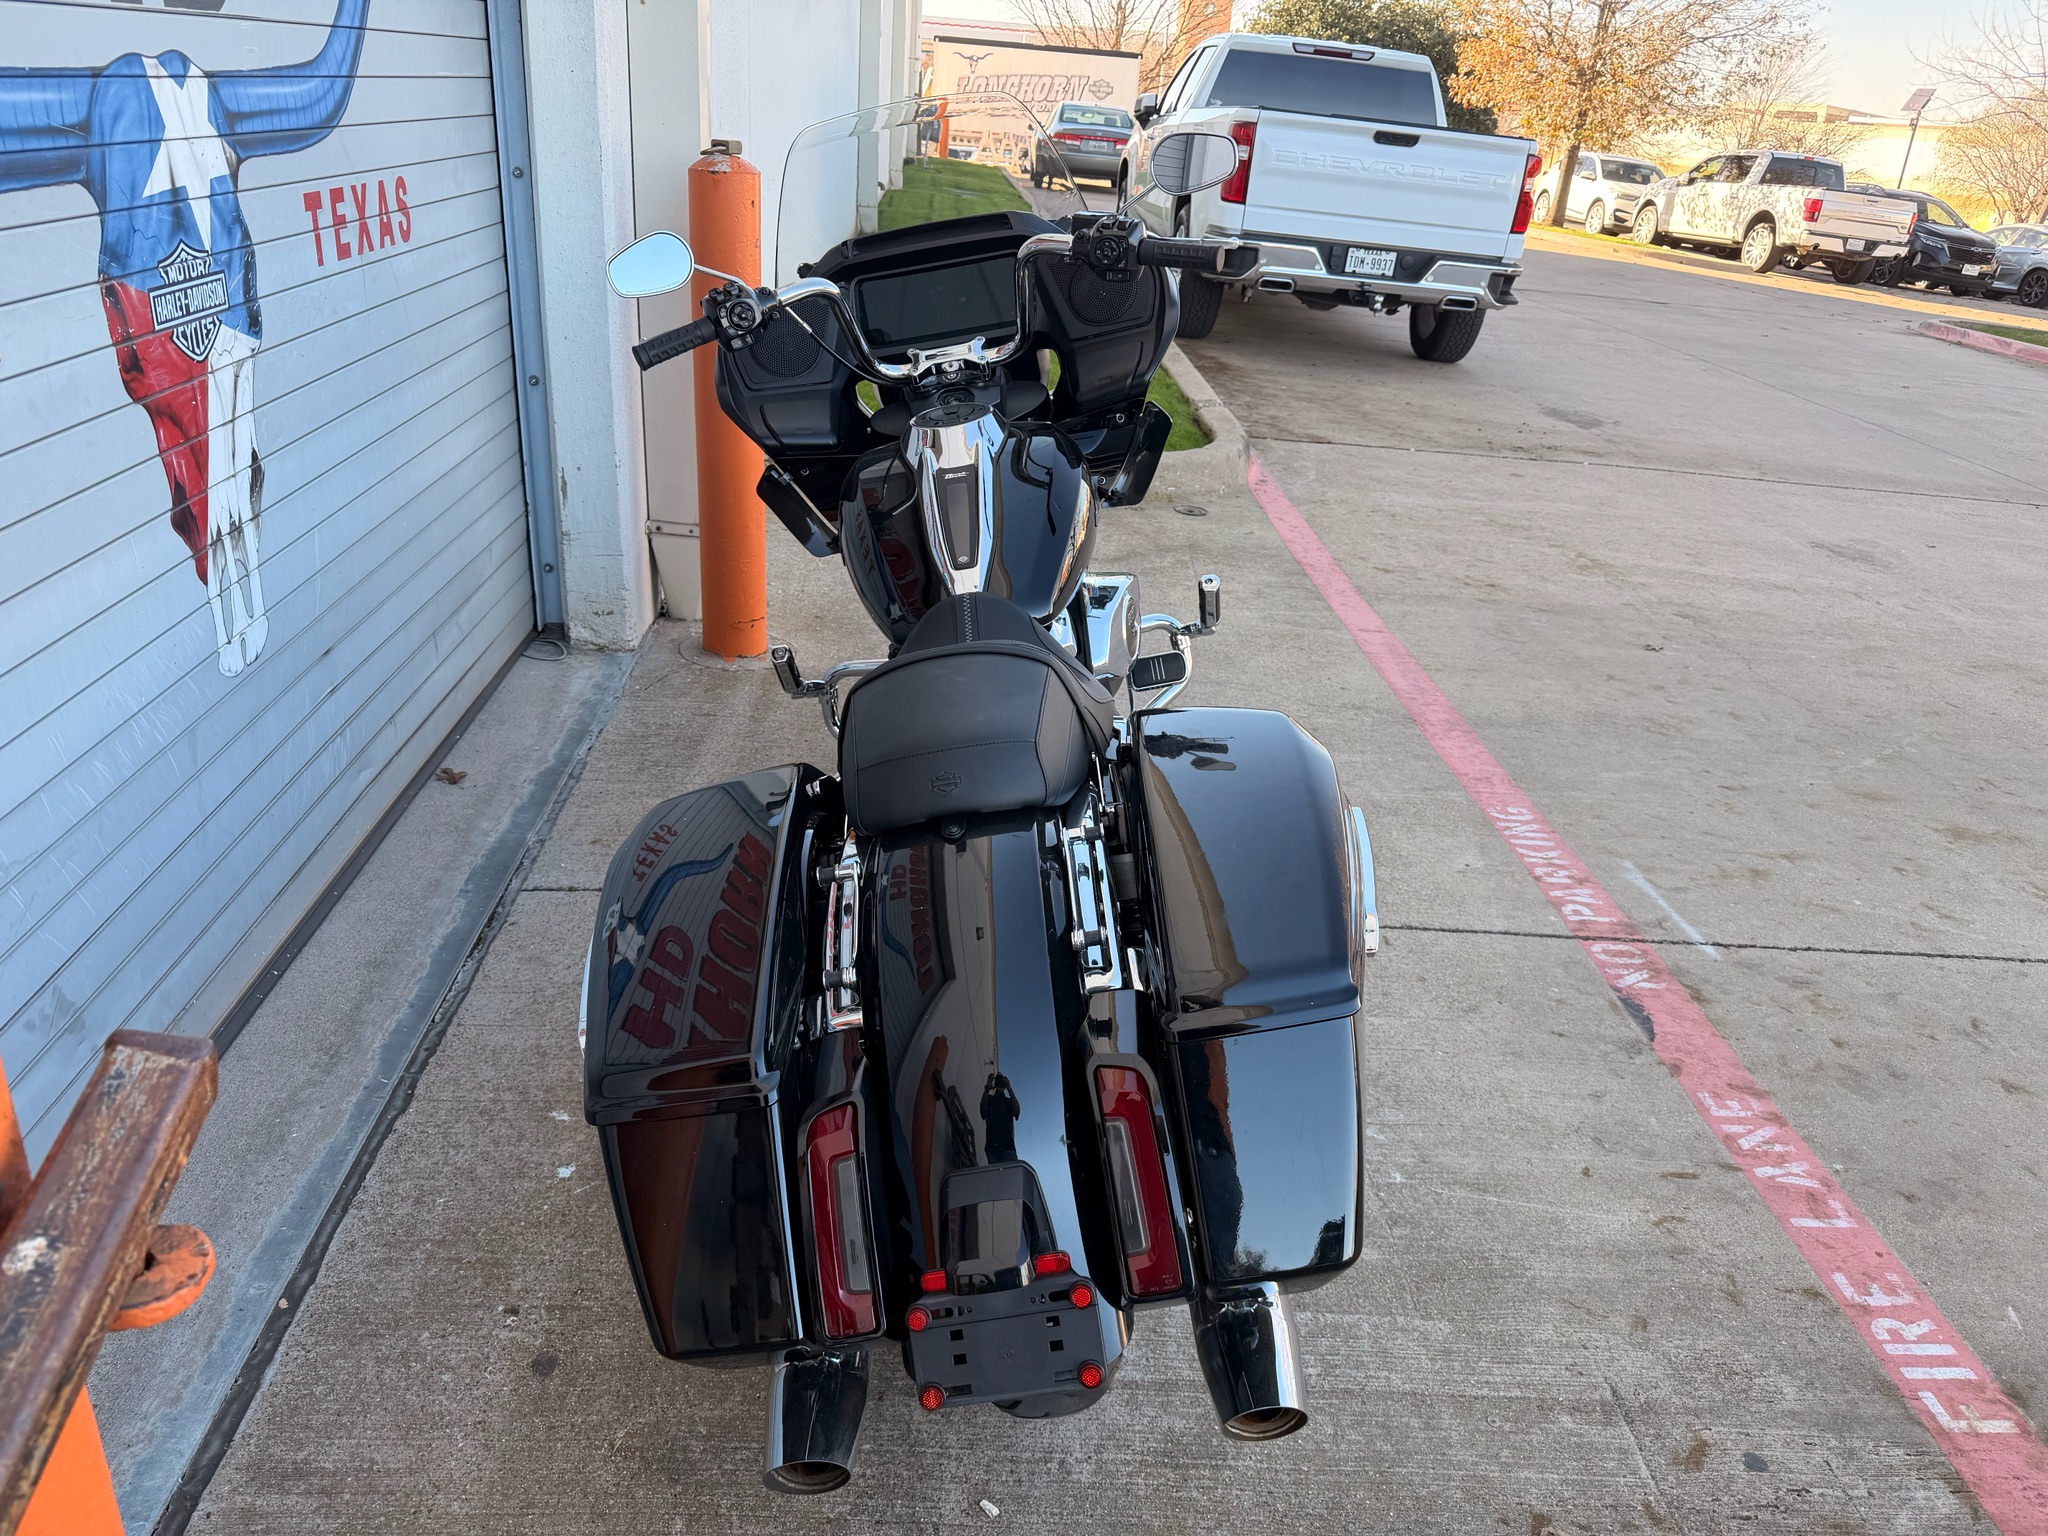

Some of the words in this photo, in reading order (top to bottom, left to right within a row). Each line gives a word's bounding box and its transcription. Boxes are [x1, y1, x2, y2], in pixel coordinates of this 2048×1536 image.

[957, 74, 1090, 103] LONGHORN
[1272, 149, 1507, 189] CHEVROLET
[303, 175, 412, 267] TEXAS
[167, 259, 208, 284] MOTOR
[155, 280, 225, 322] HARLEY-DAVIDSON
[180, 315, 215, 355] CYCLES
[1488, 806, 1617, 922] PARKING
[1590, 943, 1668, 989] NO
[1697, 1091, 1859, 1228] LANE
[1831, 1271, 2020, 1435] FIRE
